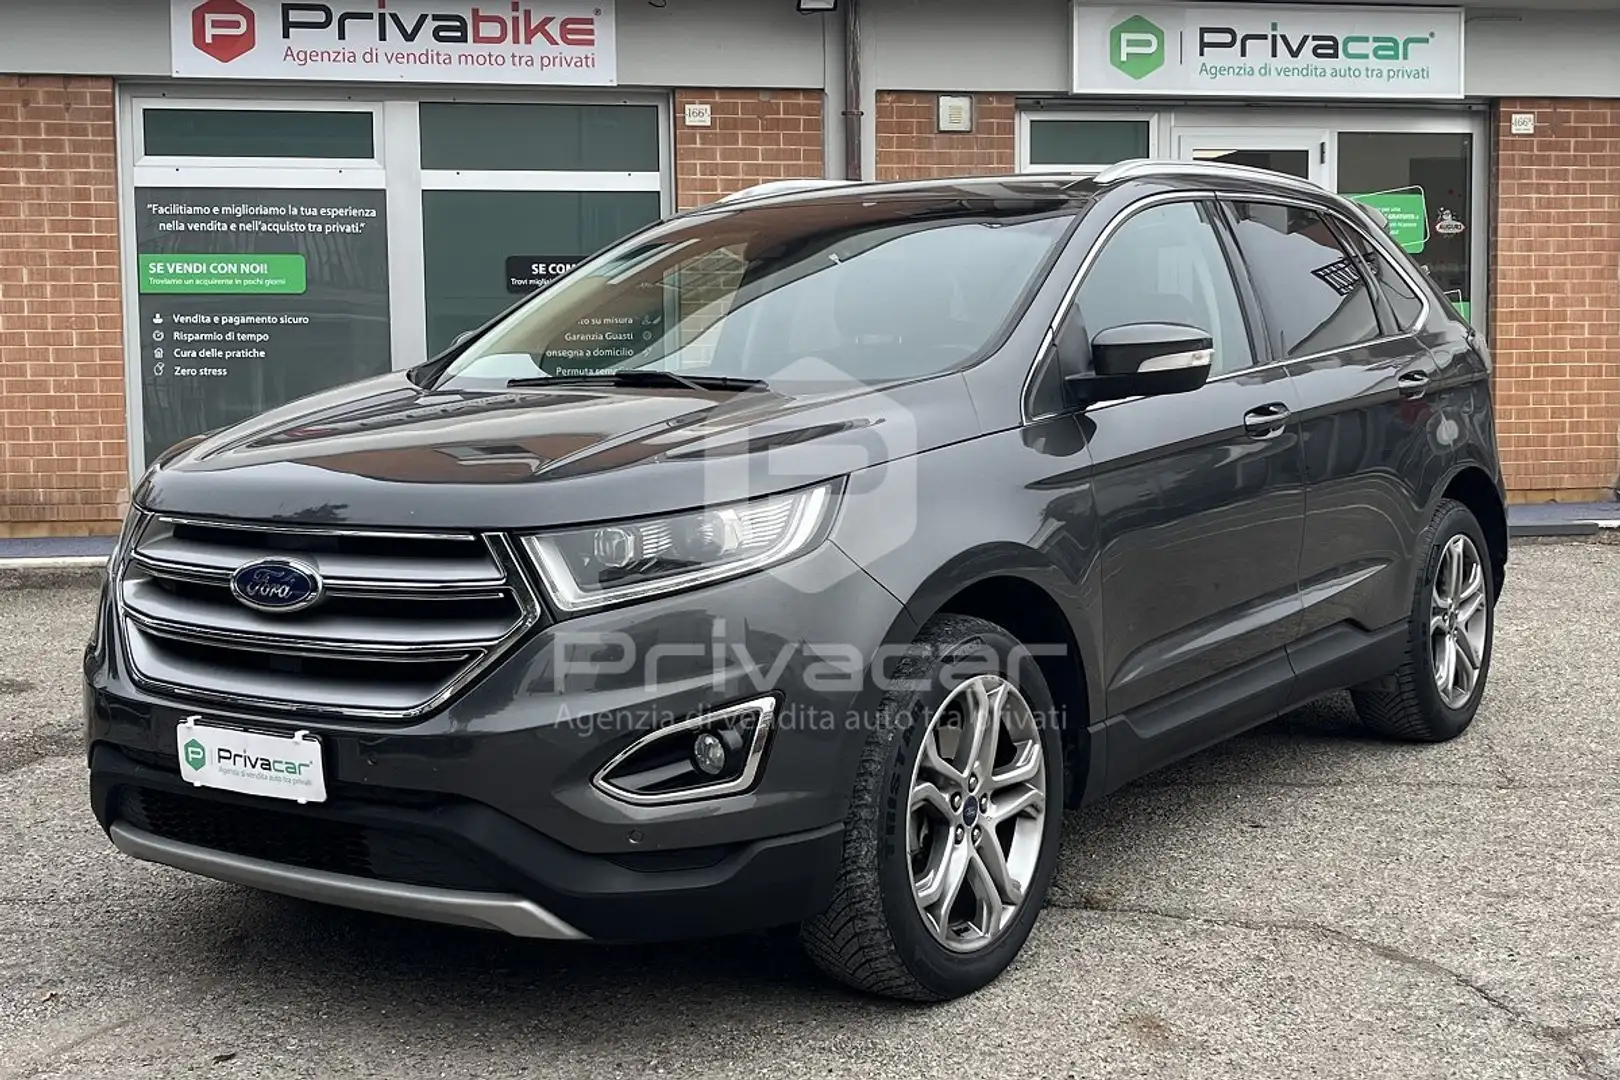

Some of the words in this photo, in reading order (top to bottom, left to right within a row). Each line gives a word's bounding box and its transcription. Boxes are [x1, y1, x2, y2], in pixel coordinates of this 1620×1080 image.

[283, 46, 357, 66] Agenzia
[361, 47, 379, 64] di
[385, 48, 453, 65] vendita
[458, 50, 506, 66] moto
[511, 51, 535, 67] tra
[540, 52, 596, 71] privati
[1199, 62, 1255, 79] Agenzia
[1258, 63, 1272, 77] di
[1275, 64, 1327, 78] vendita
[1330, 66, 1362, 78] auto
[1365, 66, 1383, 79] tra
[1387, 67, 1430, 82] privati
[213, 206, 220, 216] e
[222, 203, 287, 218] miglioriamo
[289, 204, 298, 216] la
[300, 205, 317, 217] tua
[320, 205, 377, 219] esperienza
[158, 221, 185, 232] nella
[187, 221, 228, 232] vendita
[230, 223, 237, 232] e
[239, 221, 306, 234] nell'acquisto
[308, 223, 323, 233] tra
[148, 263, 166, 274] SE
[167, 263, 206, 274] VENDI
[209, 263, 238, 275] CON
[240, 263, 268, 274] NOI!
[531, 263, 547, 275] SE
[548, 263, 577, 275] COM
[149, 277, 183, 285] Troviamo
[196, 279, 233, 287] acquirente
[243, 278, 263, 287] pochi
[264, 278, 286, 288] giorni
[529, 277, 552, 287] miglia
[172, 314, 212, 324] Vendita
[213, 316, 220, 324] e
[221, 315, 278, 326] pagamento
[279, 315, 310, 325] sicuro
[591, 317, 602, 325] su
[603, 316, 633, 325] misura
[173, 331, 224, 342] Risparmio
[225, 331, 235, 341] di
[237, 332, 270, 342] tempo
[564, 331, 604, 341] Garanzia
[605, 331, 634, 341] Guasti
[173, 348, 197, 358] Cura
[199, 348, 224, 358] delle
[225, 348, 266, 360] pratiche
[545, 349, 585, 359] onsegna
[585, 349, 592, 358] a
[592, 347, 634, 357] domicilio
[174, 366, 198, 376] Zero
[199, 366, 228, 376] stress
[556, 367, 595, 376] Permuta
[246, 568, 296, 599] Ford
[217, 748, 311, 775] Privacar
